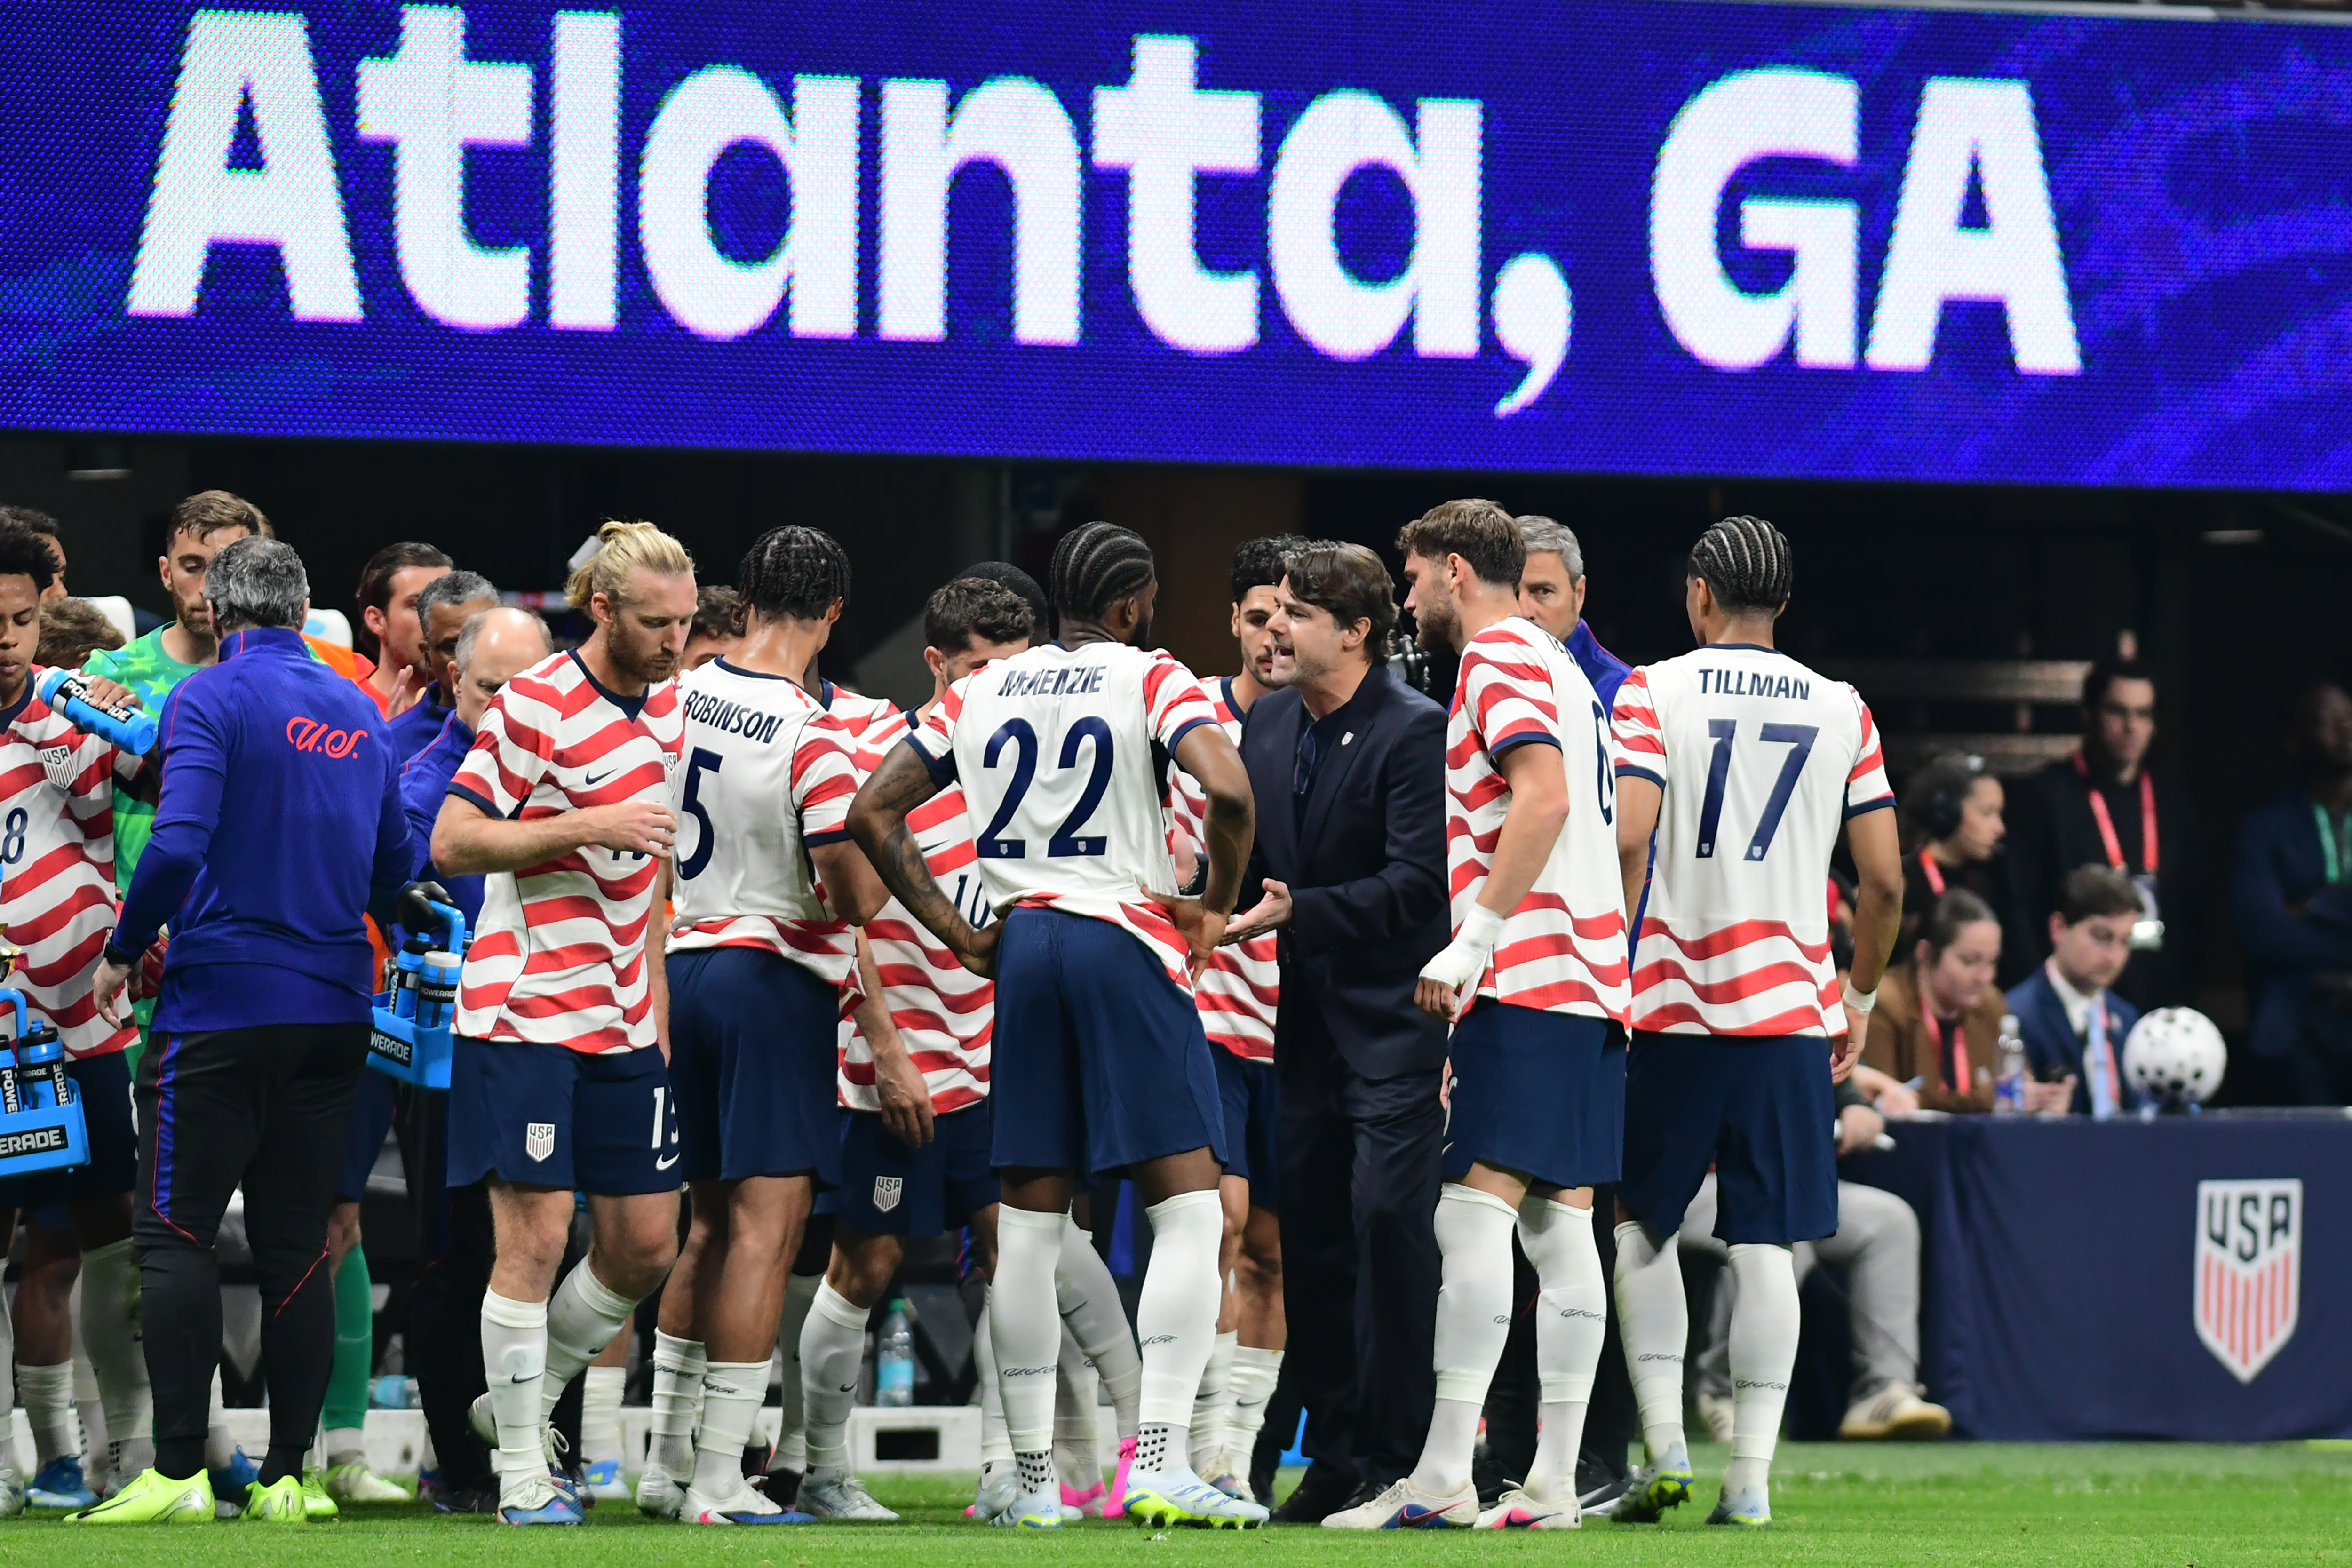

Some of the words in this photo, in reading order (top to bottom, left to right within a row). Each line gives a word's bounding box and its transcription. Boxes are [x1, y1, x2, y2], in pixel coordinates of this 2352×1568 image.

[127, 8, 1572, 416] Atlanta,
[1649, 72, 2082, 375] GA
[63, 680, 130, 721] POWADE
[1699, 669, 1810, 700] TILLMAN
[686, 689, 785, 744] ROBINSON
[42, 747, 69, 765] USA
[664, 754, 676, 772] USA
[977, 716, 1113, 859] 22
[1695, 718, 1820, 861] 17
[676, 745, 723, 881] 5
[954, 874, 991, 929] 10
[371, 1031, 410, 1060] WERADE
[530, 1125, 553, 1139] USA
[878, 1177, 901, 1192] USA
[2208, 1194, 2290, 1263] USA
